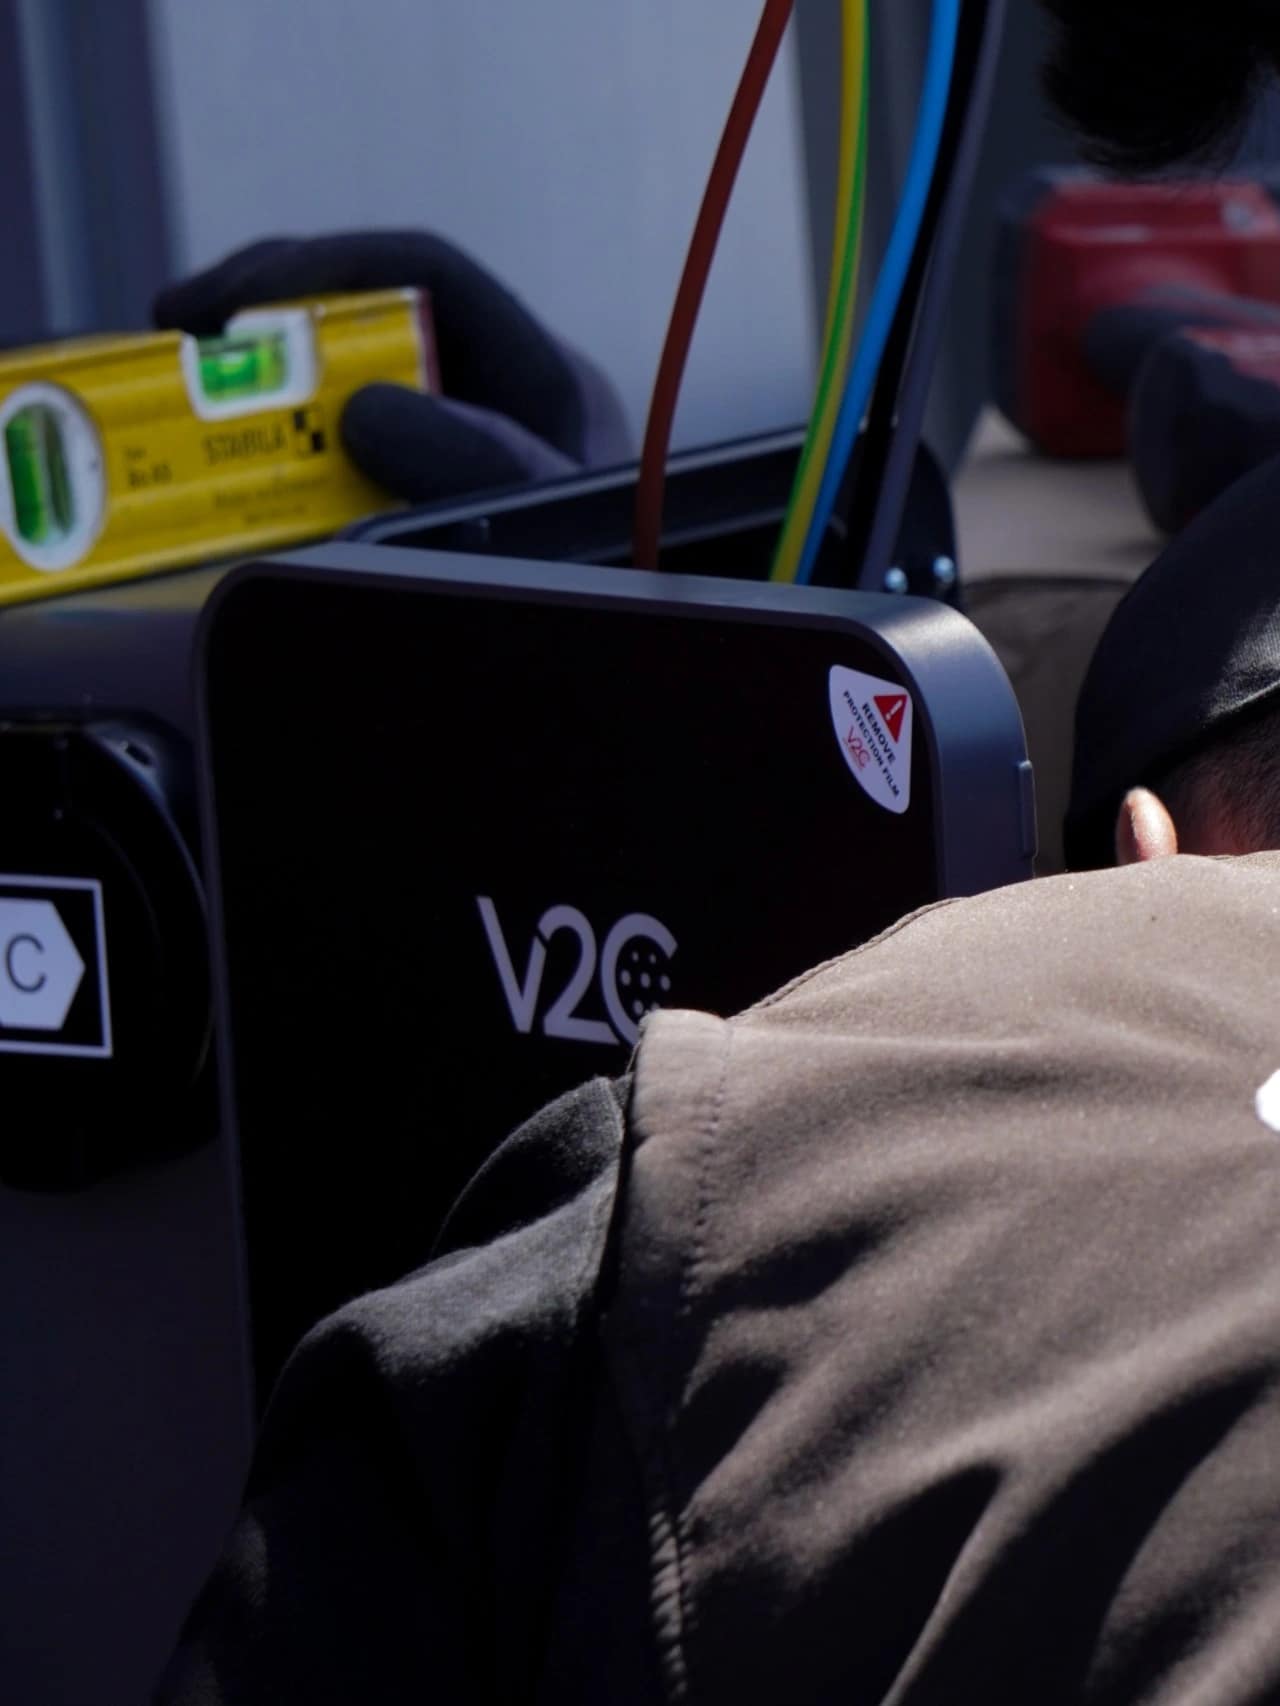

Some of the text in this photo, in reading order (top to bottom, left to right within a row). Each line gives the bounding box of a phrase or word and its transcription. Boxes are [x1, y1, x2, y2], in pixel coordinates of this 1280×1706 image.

[843, 690, 900, 798] PROTECTION FILM
[847, 726, 871, 769] V2C
[862, 702, 896, 764] REMOVE
[5, 933, 47, 993] C
[476, 895, 678, 1048] V2C
